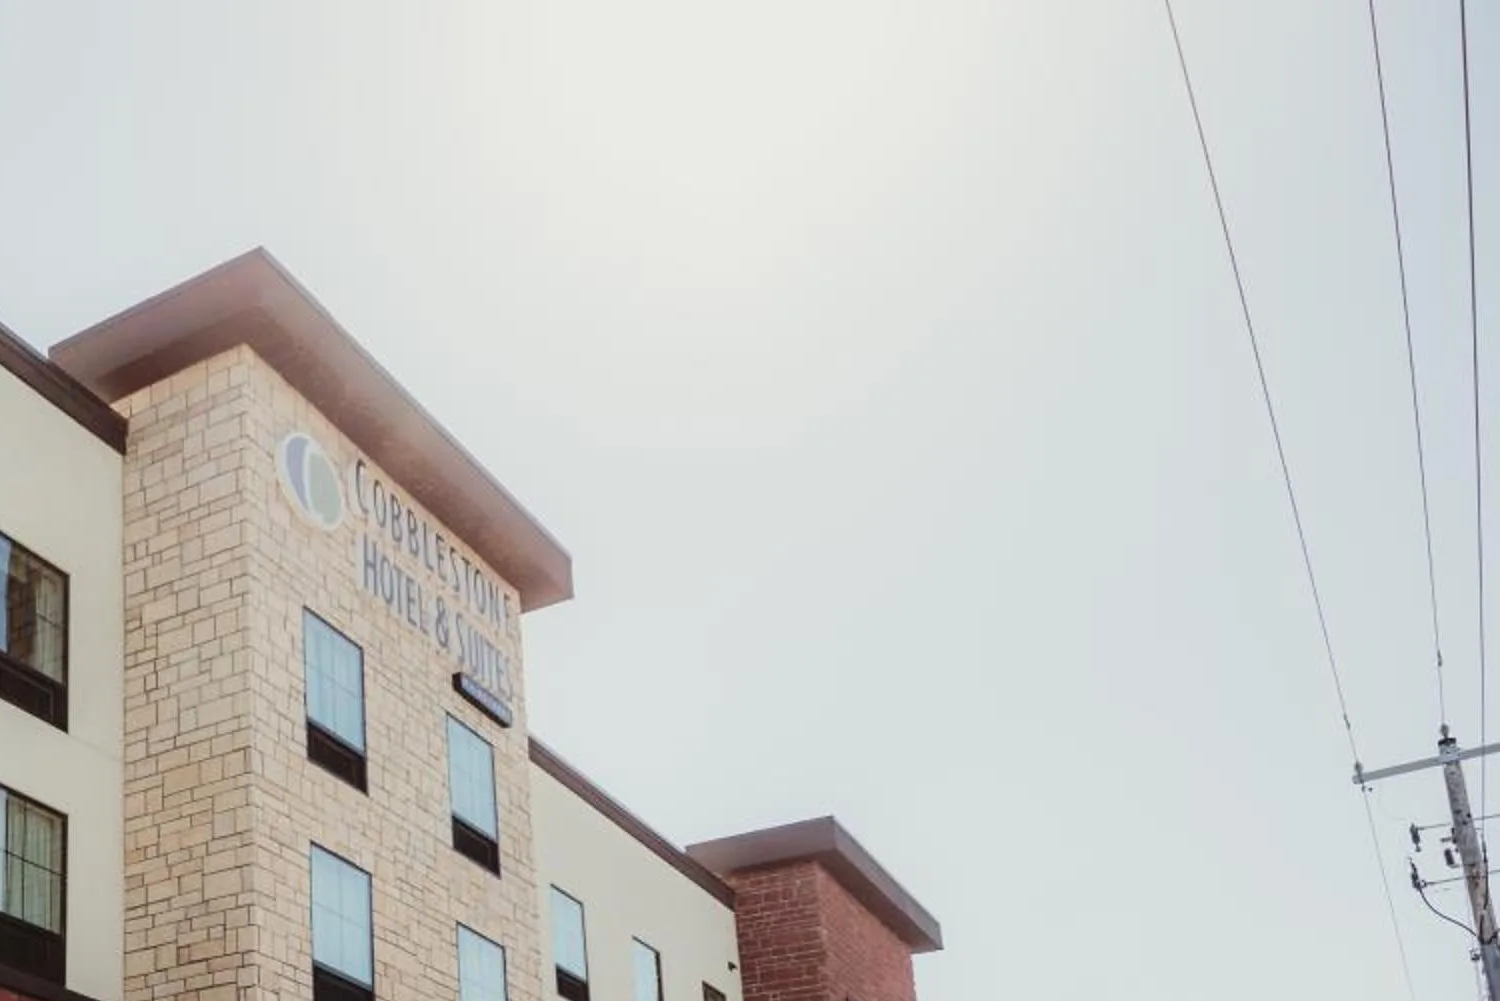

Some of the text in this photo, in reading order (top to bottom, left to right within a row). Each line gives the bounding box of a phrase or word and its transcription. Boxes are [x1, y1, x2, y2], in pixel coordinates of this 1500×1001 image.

[355, 460, 511, 631] COBBLESTONE
[362, 533, 430, 638] HOTEL
[435, 596, 449, 649] &
[455, 613, 513, 702] SUITES
